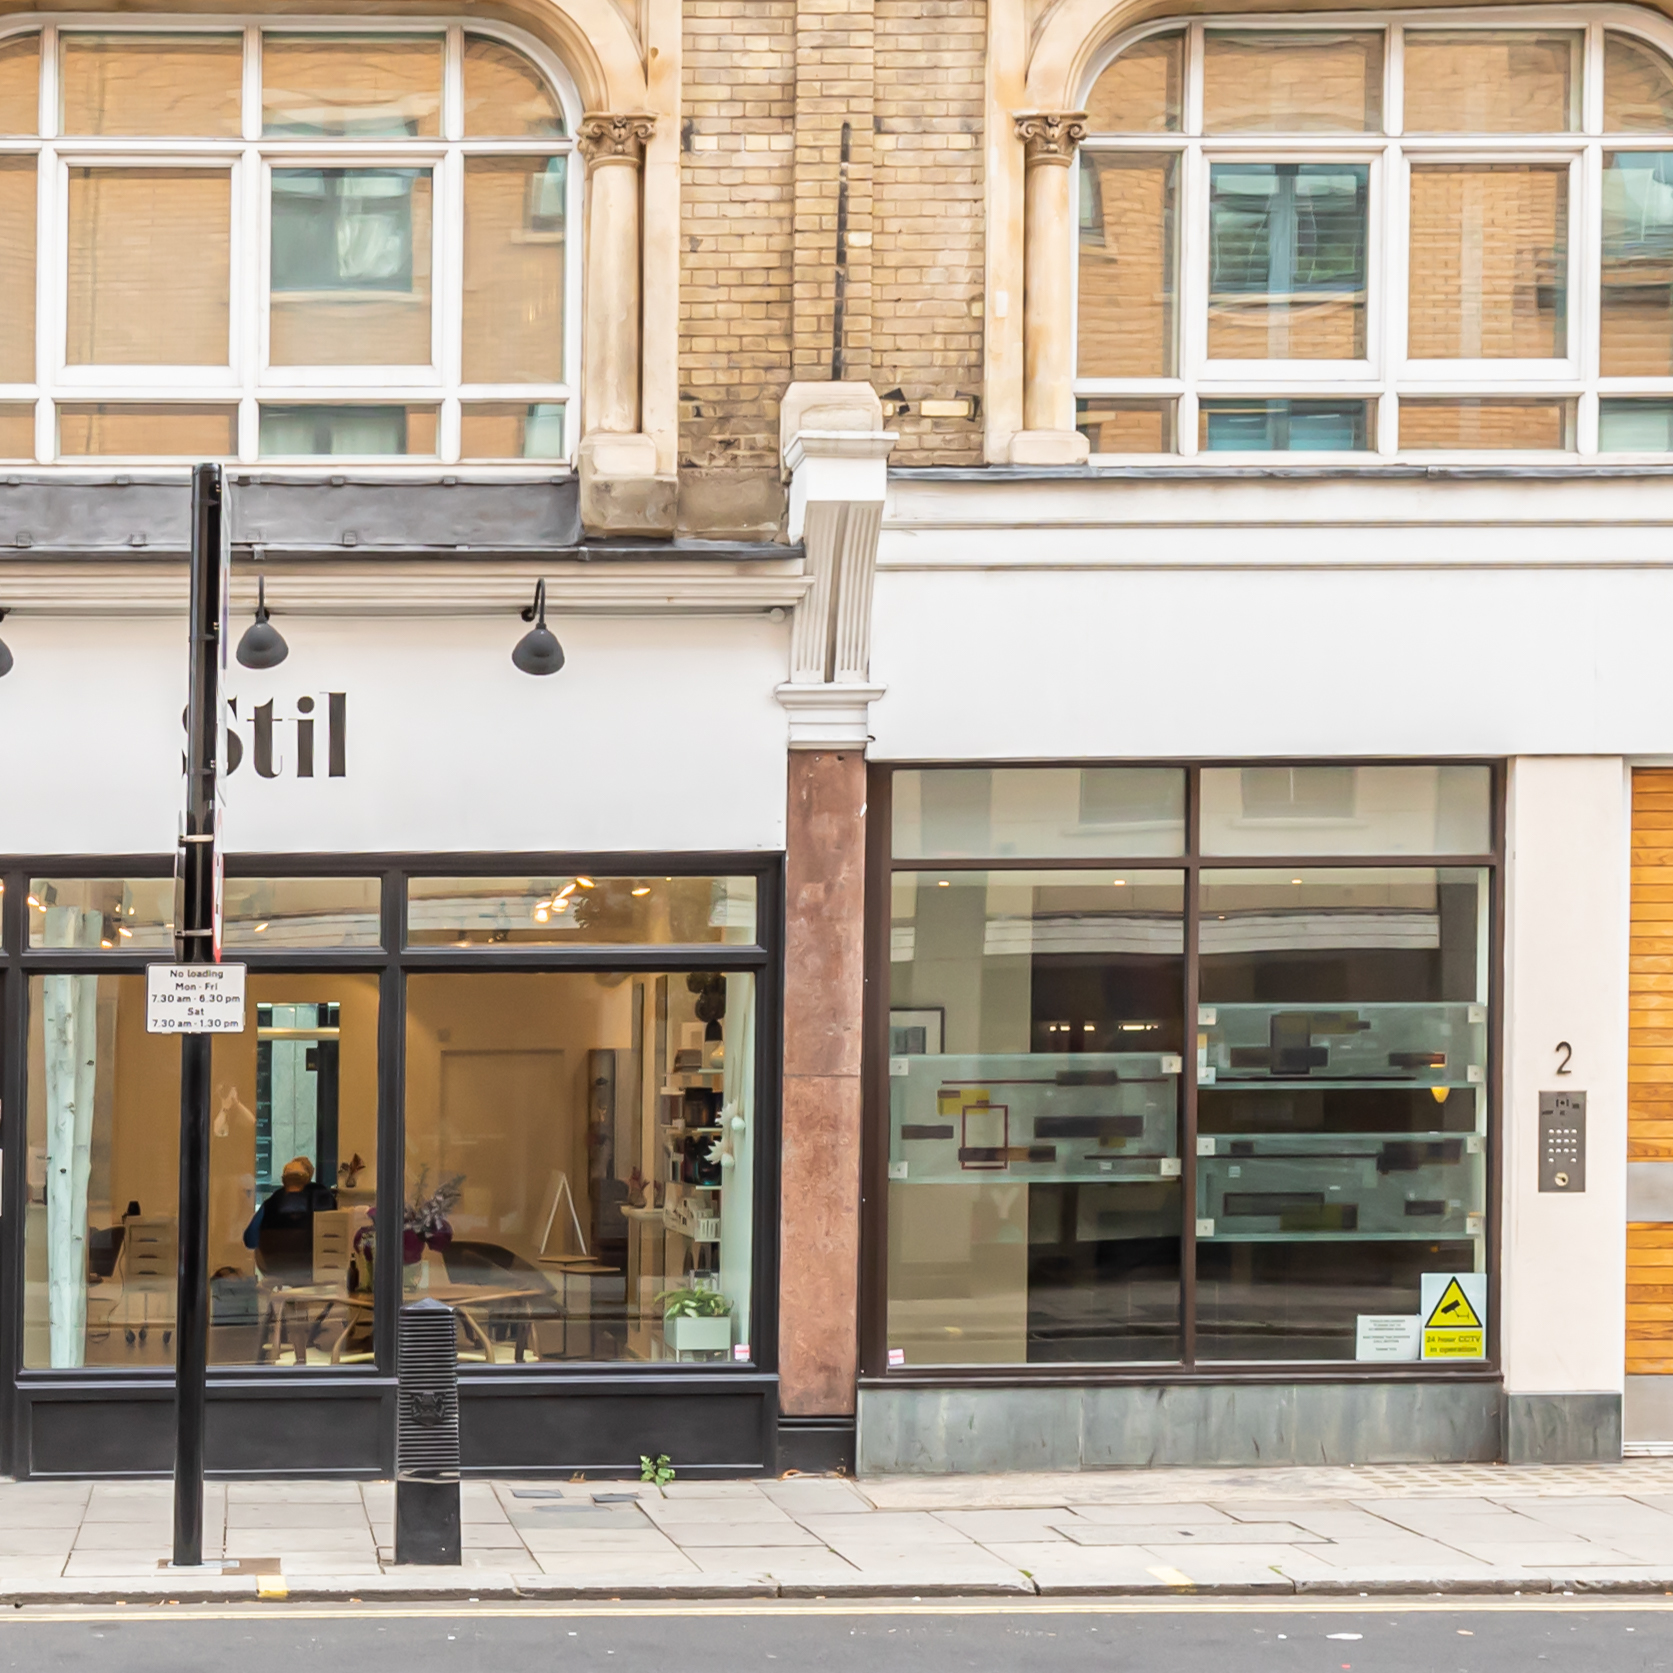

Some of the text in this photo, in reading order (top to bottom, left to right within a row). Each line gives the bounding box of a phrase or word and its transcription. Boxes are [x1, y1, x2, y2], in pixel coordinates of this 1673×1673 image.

[169, 969, 224, 979] No loading
[175, 982, 197, 991] Mon
[204, 982, 218, 991] Fri
[152, 994, 175, 1003] 7.30
[177, 995, 191, 1003] am
[199, 994, 223, 1003] 6.30
[225, 995, 240, 1004] pm
[187, 1007, 205, 1016] Sat
[152, 1019, 175, 1027] 7.30
[200, 1019, 221, 1027] 1.30
[224, 1020, 239, 1029] pm
[1555, 1041, 1572, 1075] 2
